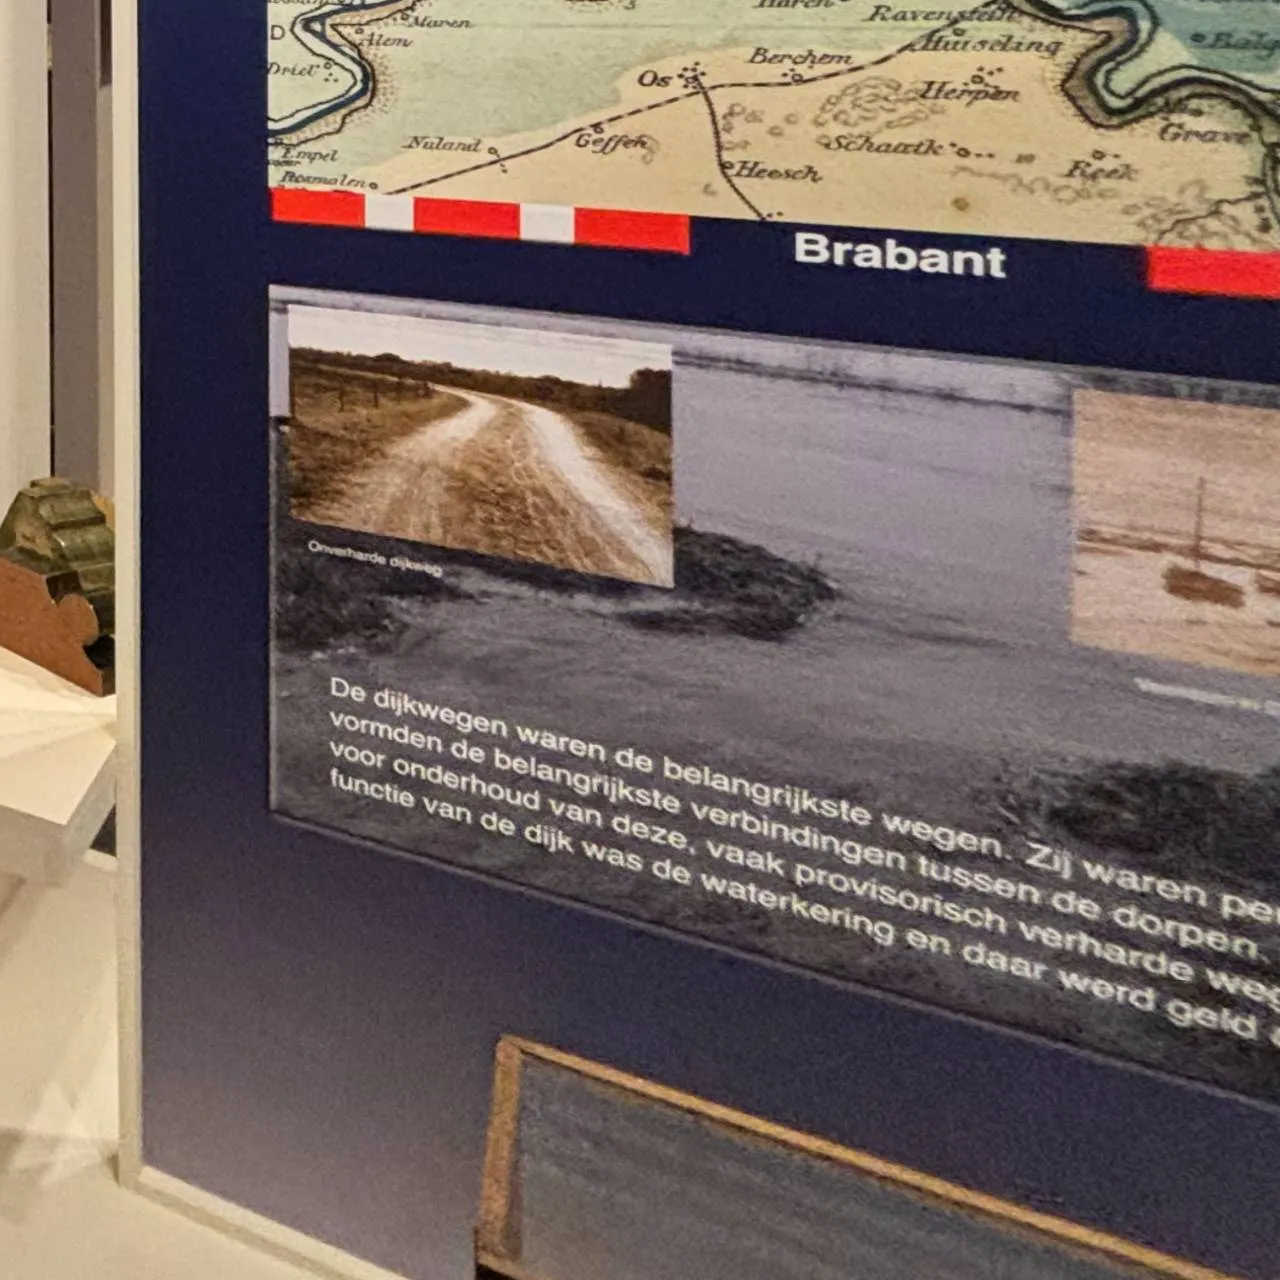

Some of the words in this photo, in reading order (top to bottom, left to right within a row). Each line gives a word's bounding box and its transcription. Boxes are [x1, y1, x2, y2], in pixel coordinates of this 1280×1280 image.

[636, 69, 672, 88] Os
[401, 135, 483, 154] Nuland
[573, 132, 648, 155] Geffen
[795, 232, 1006, 278] Brabant
[330, 712, 442, 752] vormden
[451, 740, 485, 763] de
[495, 748, 680, 813] belangrijkste
[691, 803, 906, 870] verbindingen
[918, 856, 1041, 904] tussen
[1052, 892, 1100, 919] de
[331, 677, 366, 701] De
[374, 689, 507, 736] dijkwegen
[516, 726, 605, 761] waren
[615, 748, 652, 772] de
[664, 756, 871, 825] belangrijkste
[882, 814, 1011, 859] wegen.
[1026, 842, 1071, 879] Zij
[1083, 860, 1207, 907] waren
[330, 742, 385, 767] voor
[394, 759, 539, 810] onderhoud
[549, 799, 602, 827] van
[612, 815, 695, 854] deze,
[707, 841, 783, 875] vaak
[795, 864, 1006, 933] provisorisch
[1018, 921, 1193, 981] verharde
[331, 768, 414, 807] functie
[423, 797, 471, 823] van
[481, 812, 515, 835] de
[525, 825, 573, 852] dijk
[582, 841, 642, 870] was
[652, 859, 691, 884] de
[701, 874, 894, 945] waterkering
[906, 929, 950, 954] en
[962, 943, 1047, 979] daar
[1058, 970, 1155, 1010] werd
[1166, 999, 1256, 1038] geld
